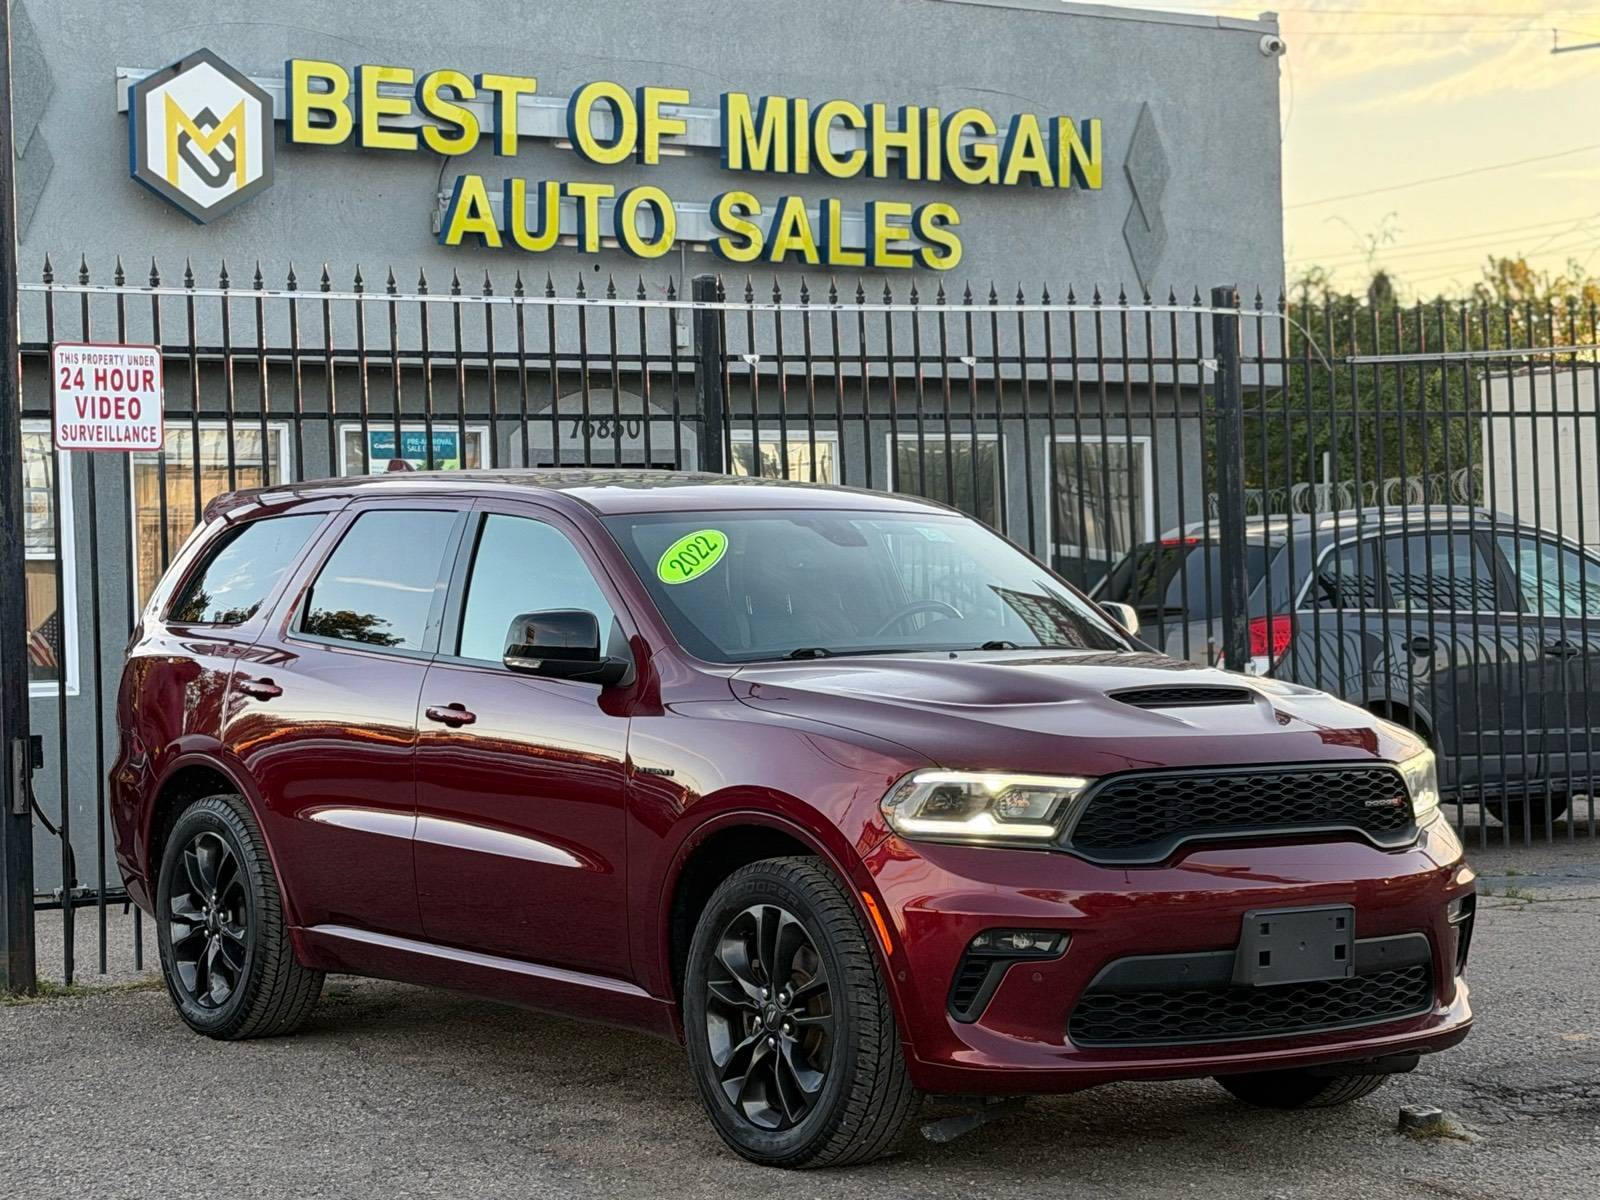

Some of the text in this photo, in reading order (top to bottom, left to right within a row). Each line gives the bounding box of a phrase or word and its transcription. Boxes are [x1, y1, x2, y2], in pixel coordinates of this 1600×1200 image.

[286, 58, 1102, 190] BEST OF MICHIGAN
[440, 174, 963, 271] AUTO SALES
[60, 352, 155, 367] THIS PROPERTY UNDER
[60, 367, 155, 392] 24 HOUR
[75, 395, 142, 420] VIDEO
[61, 424, 157, 443] SURVEILLANCE
[669, 535, 718, 577] 2022
